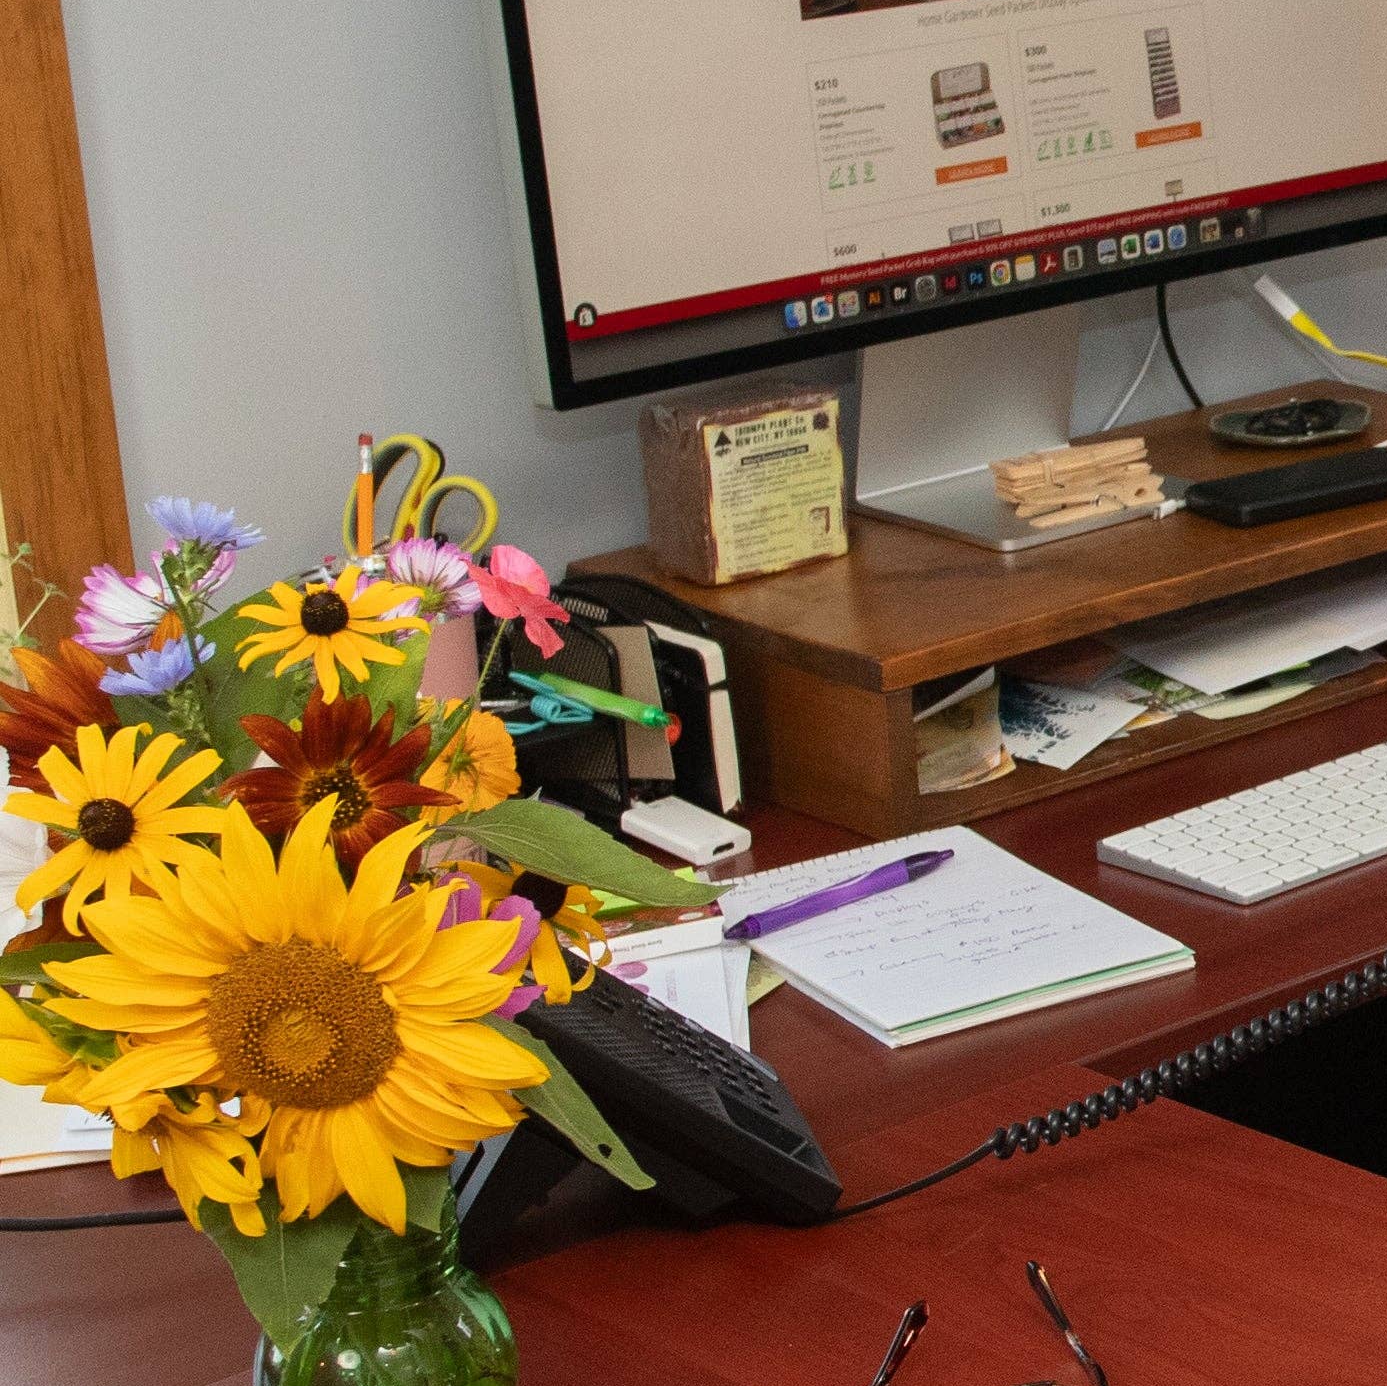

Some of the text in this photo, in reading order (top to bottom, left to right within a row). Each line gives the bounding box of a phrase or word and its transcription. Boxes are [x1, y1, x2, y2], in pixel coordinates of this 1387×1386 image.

[969, 272, 984, 285] Ps
[894, 287, 907, 299] Br
[768, 416, 792, 429] PLANT
